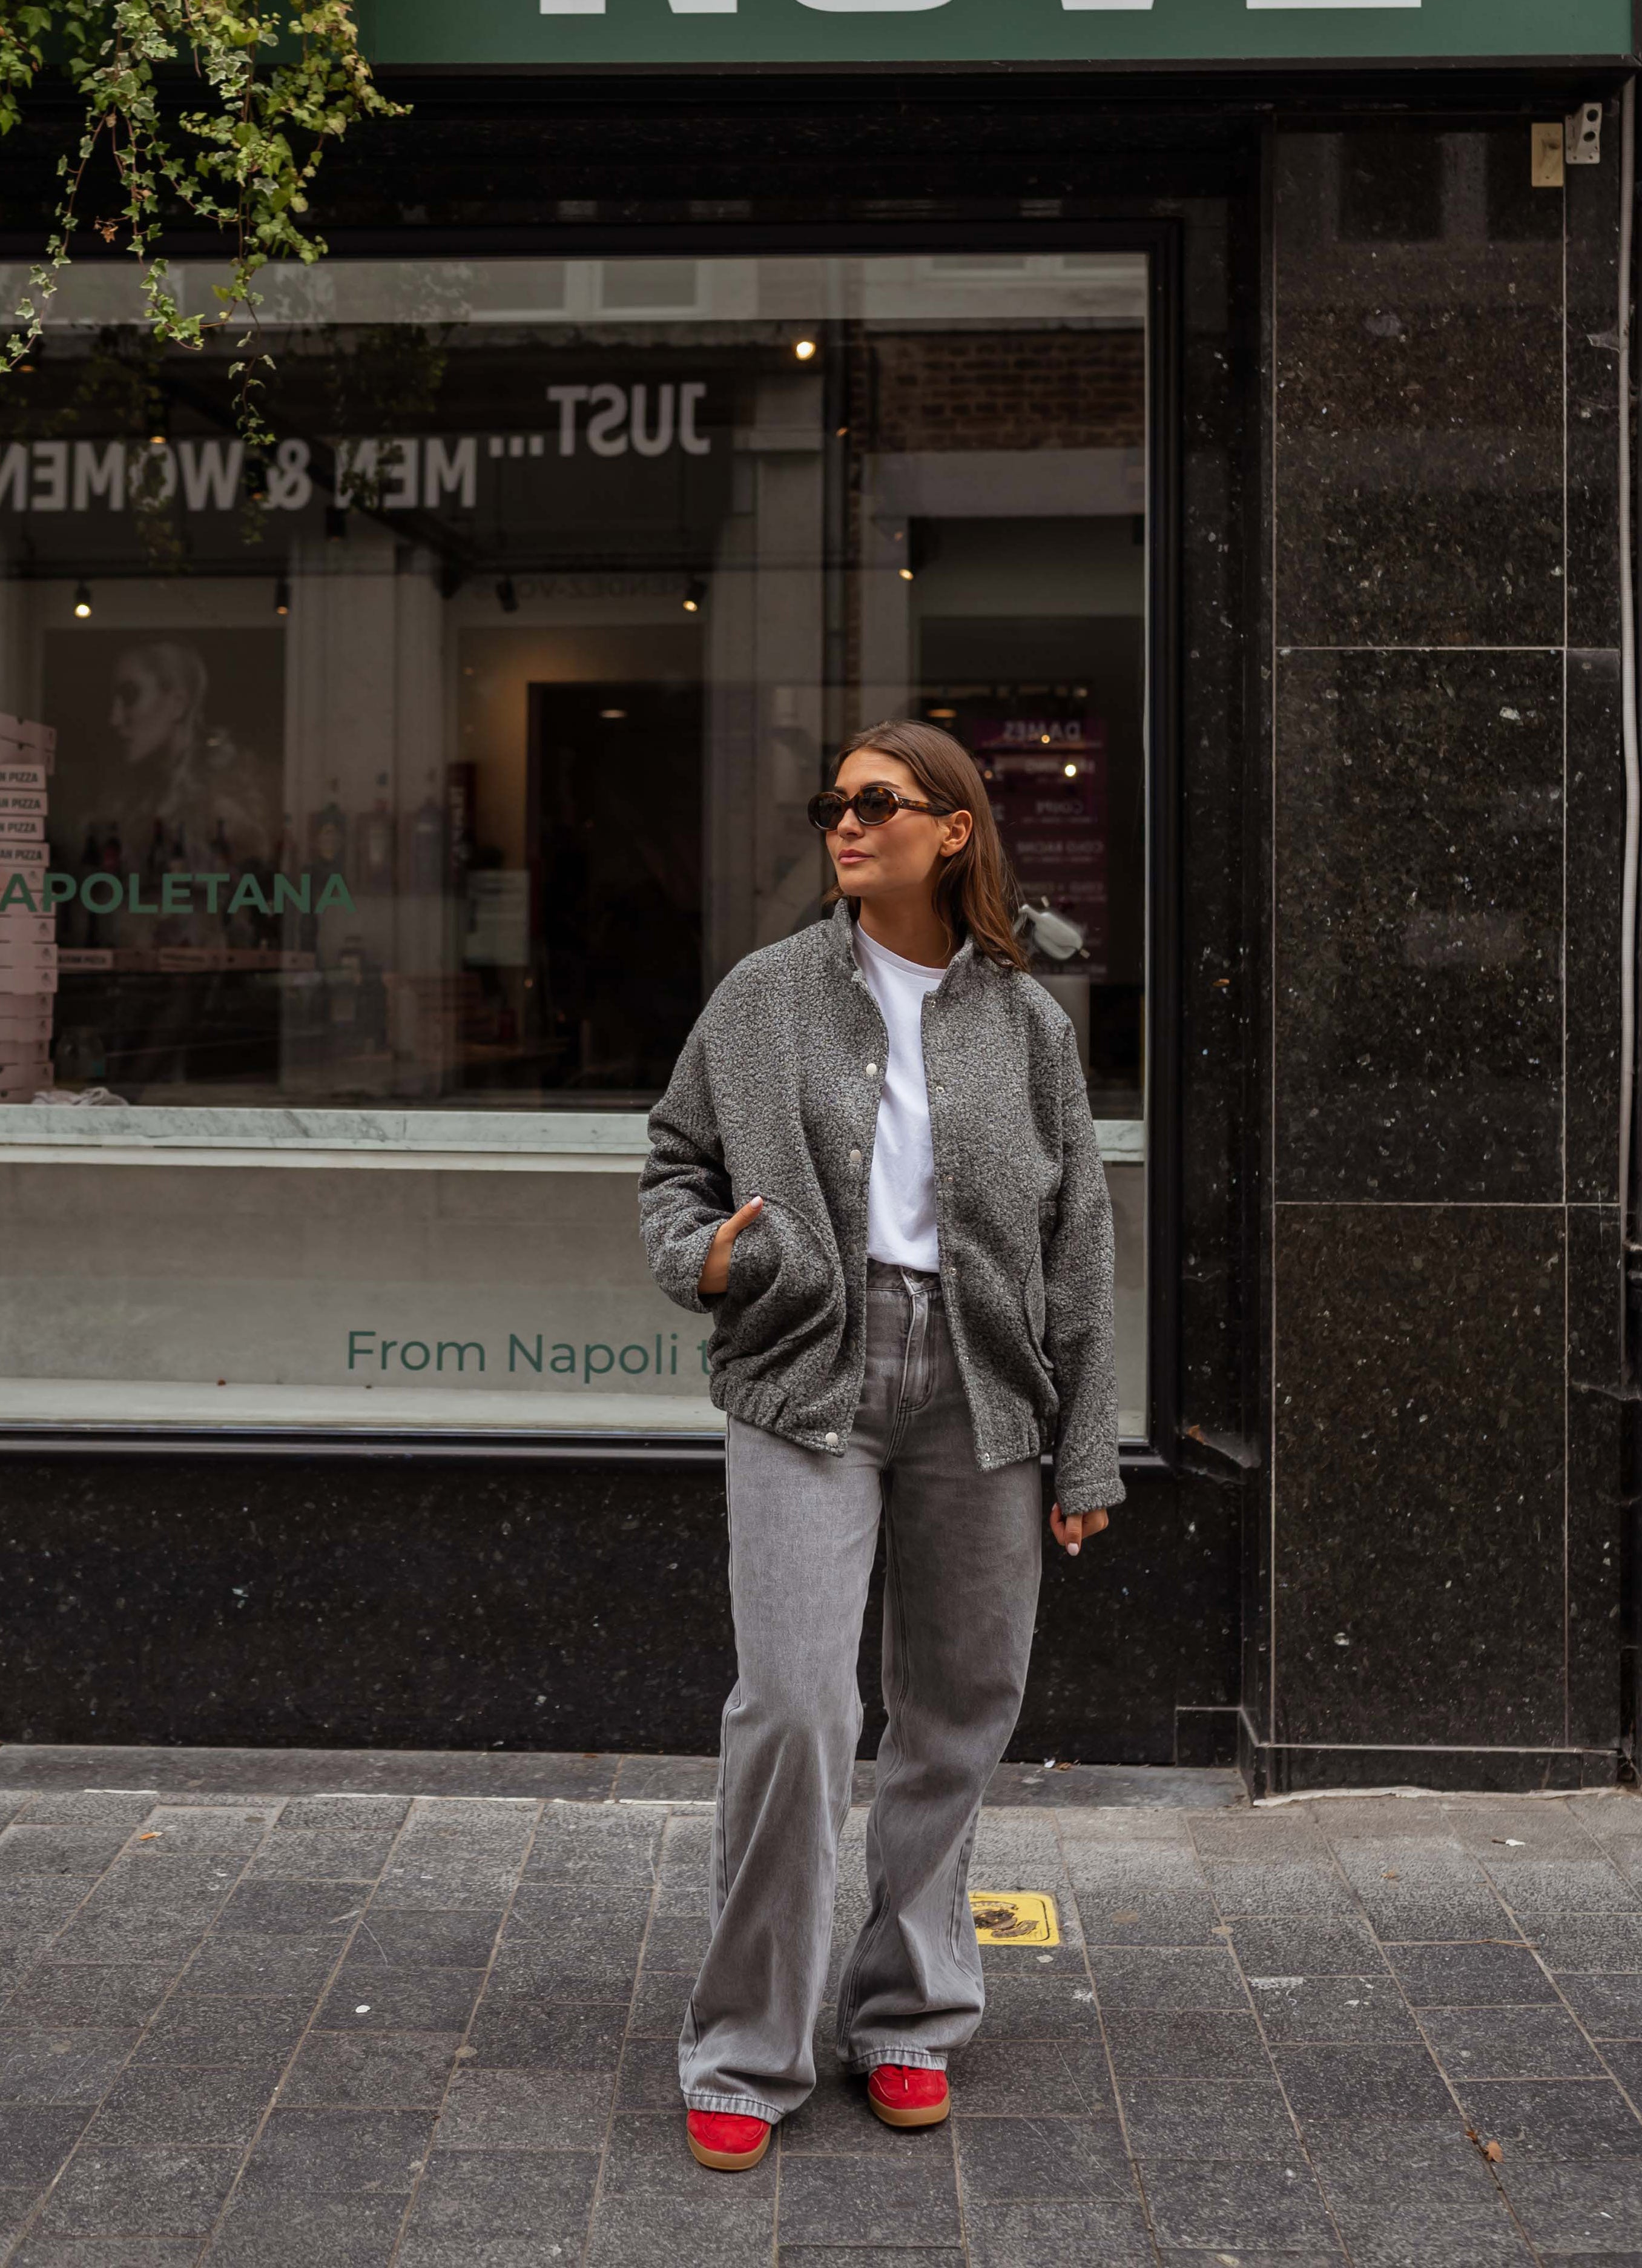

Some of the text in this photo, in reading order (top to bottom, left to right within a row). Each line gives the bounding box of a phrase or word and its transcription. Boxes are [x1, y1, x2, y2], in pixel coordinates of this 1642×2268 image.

[9, 772, 38, 783] PIZZA
[12, 798, 41, 809] PIZZA
[7, 822, 36, 833] PIZZA
[15, 849, 42, 861] PIZZA
[0, 872, 357, 914] APOLETANA
[347, 1331, 485, 1372] From
[508, 1332, 678, 1384] Napoli
